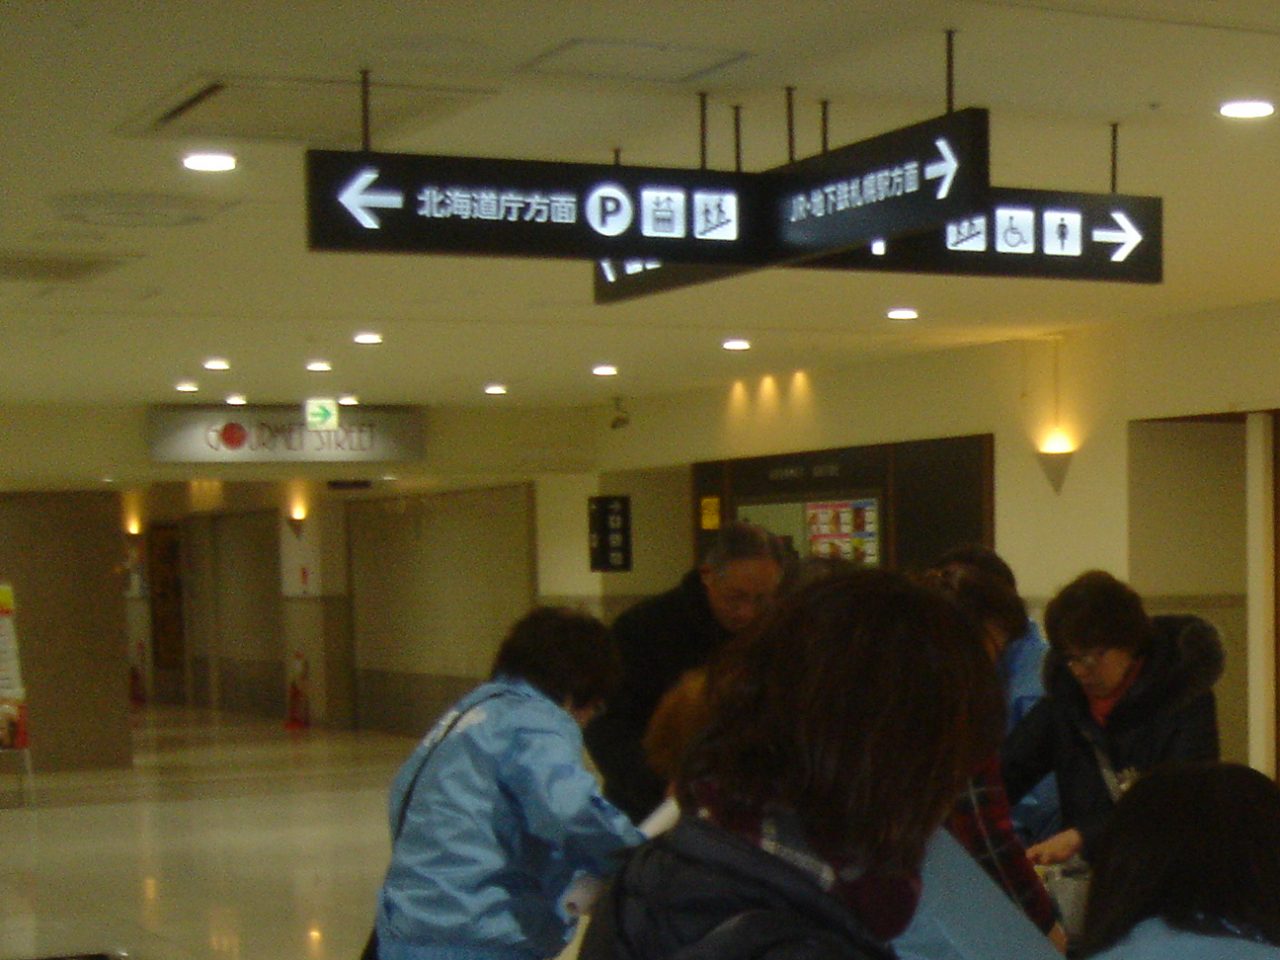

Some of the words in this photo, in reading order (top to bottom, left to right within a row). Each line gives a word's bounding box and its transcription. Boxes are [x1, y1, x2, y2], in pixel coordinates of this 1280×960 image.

[416, 186, 578, 225] 北海道庁方面
